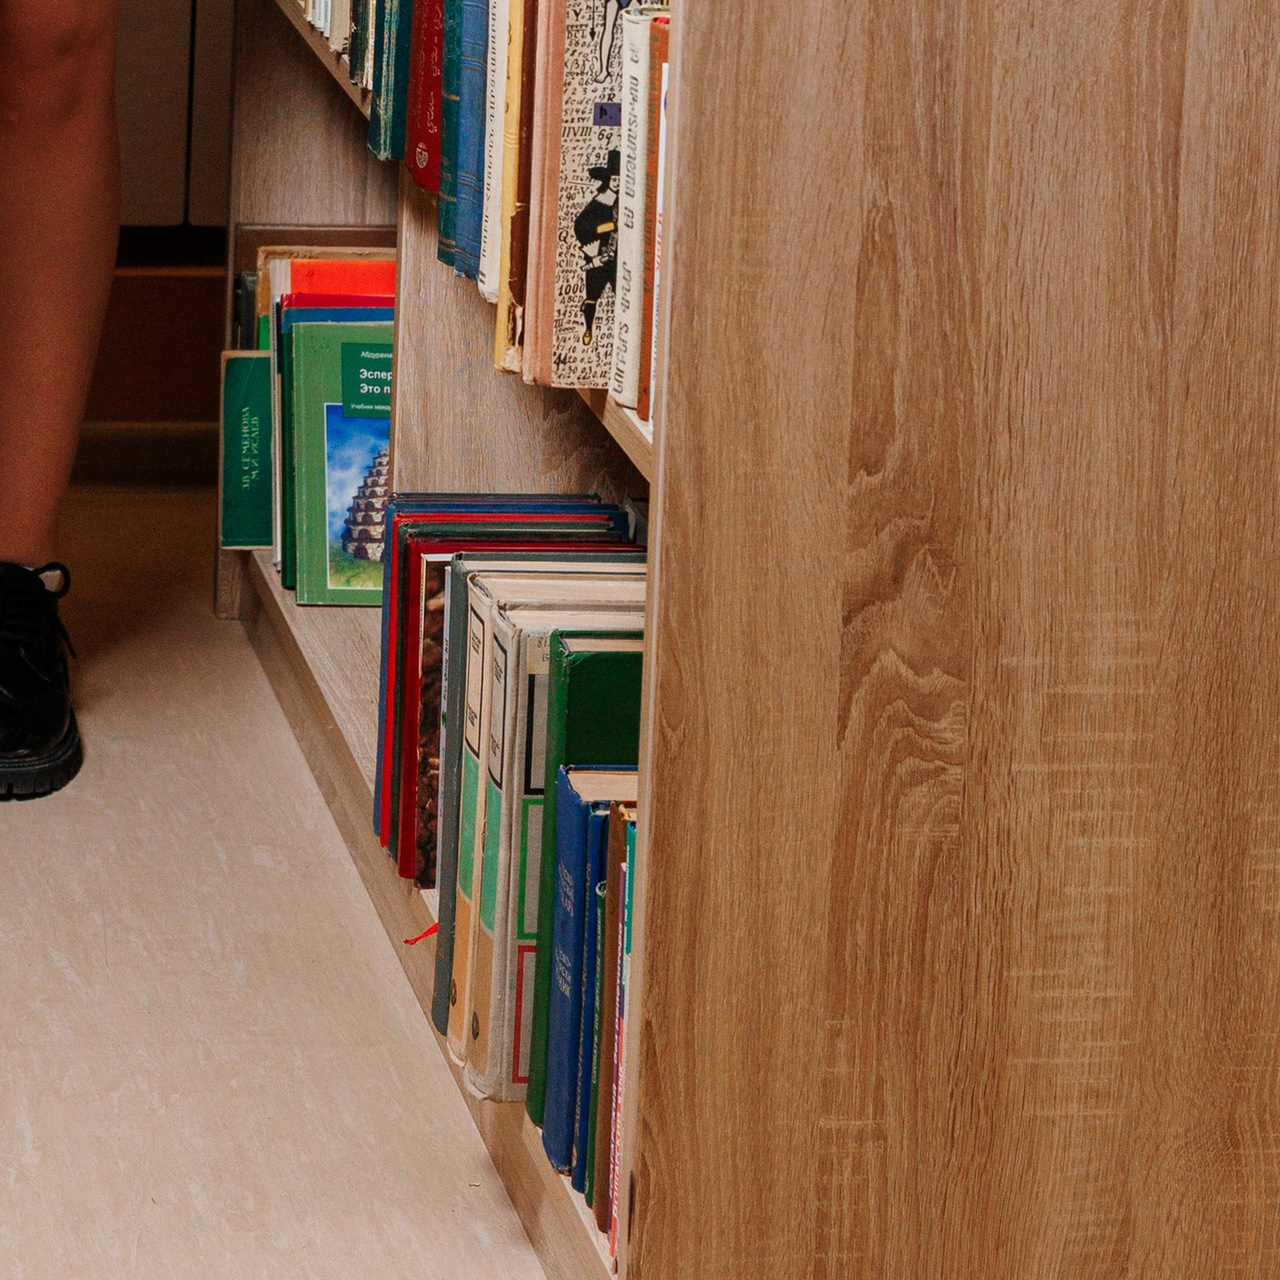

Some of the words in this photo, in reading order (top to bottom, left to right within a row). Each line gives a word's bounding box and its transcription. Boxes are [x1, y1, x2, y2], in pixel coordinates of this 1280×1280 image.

[359, 383, 381, 395] Это
[241, 406, 251, 471] СЕМЕНОВА
[250, 416, 260, 455] ИСАЕВ
[591, 1033, 600, 1084] СЛОВАРЬ
